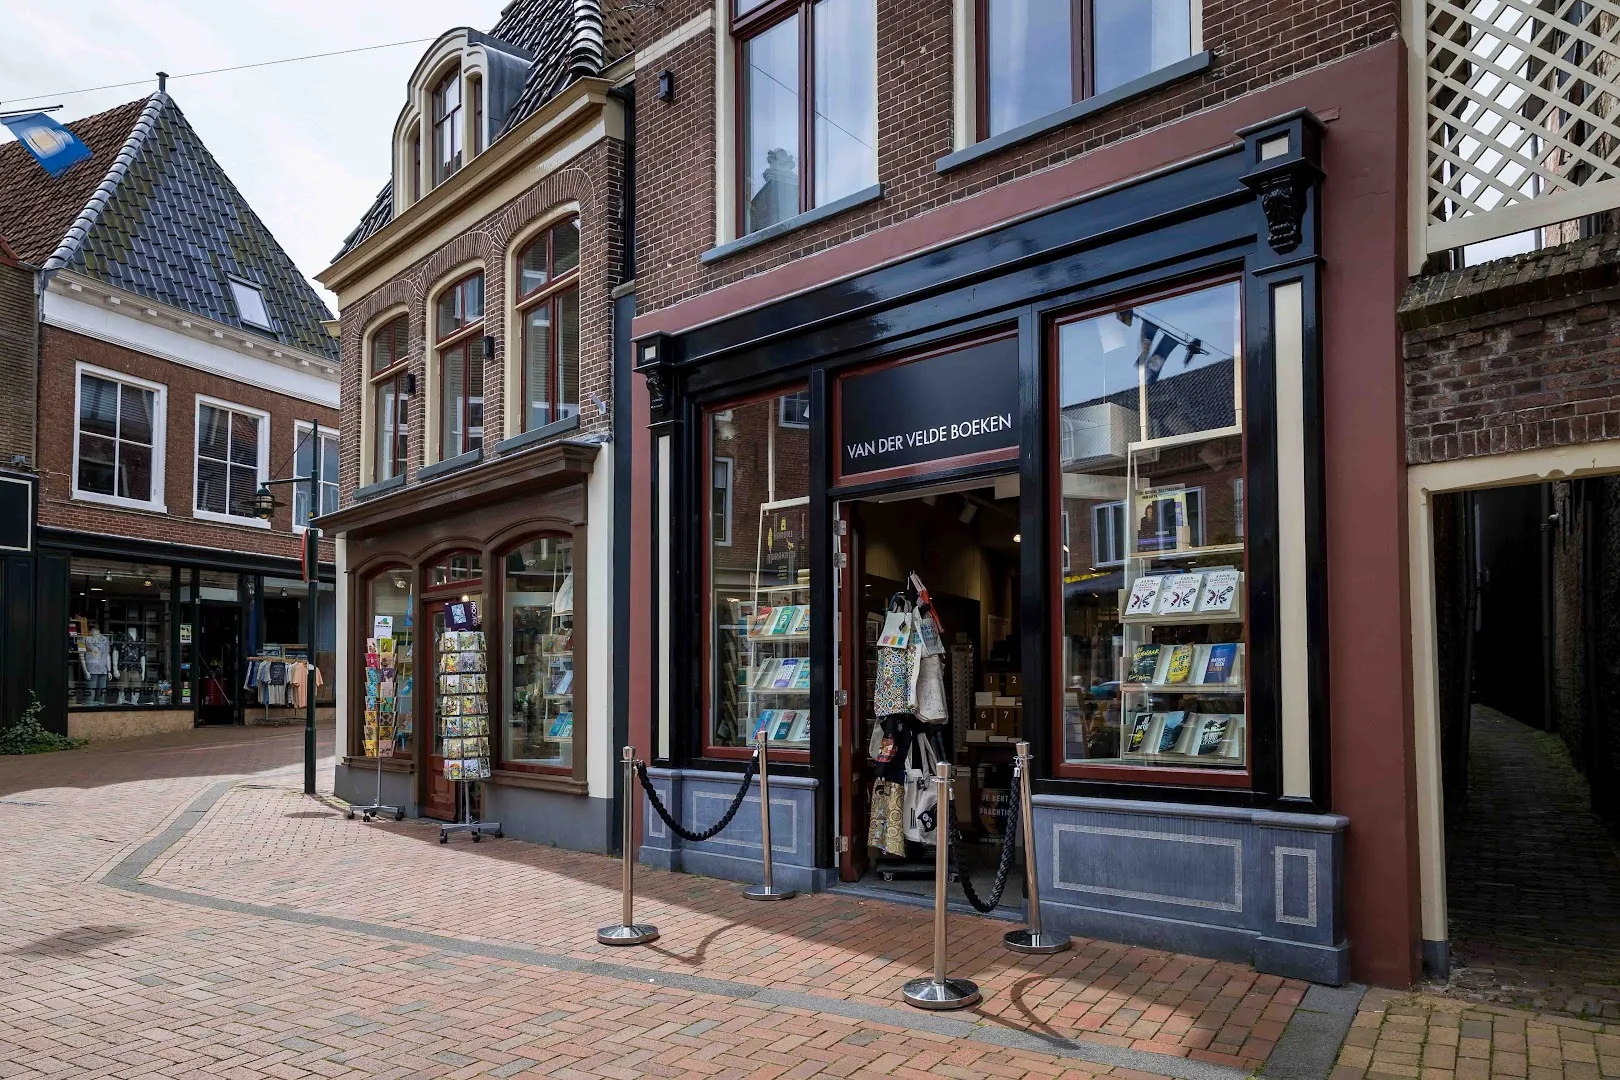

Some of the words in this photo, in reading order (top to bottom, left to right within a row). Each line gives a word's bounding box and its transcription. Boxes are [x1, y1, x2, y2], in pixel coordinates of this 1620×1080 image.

[847, 440, 875, 459] VAN
[878, 435, 903, 453] DER
[906, 425, 947, 448] VELDE
[950, 413, 1012, 440] BOEKEN
[1011, 676, 1017, 684] 2
[981, 711, 986, 719] 6
[1004, 711, 1009, 719] 7
[992, 794, 1009, 802] BENT
